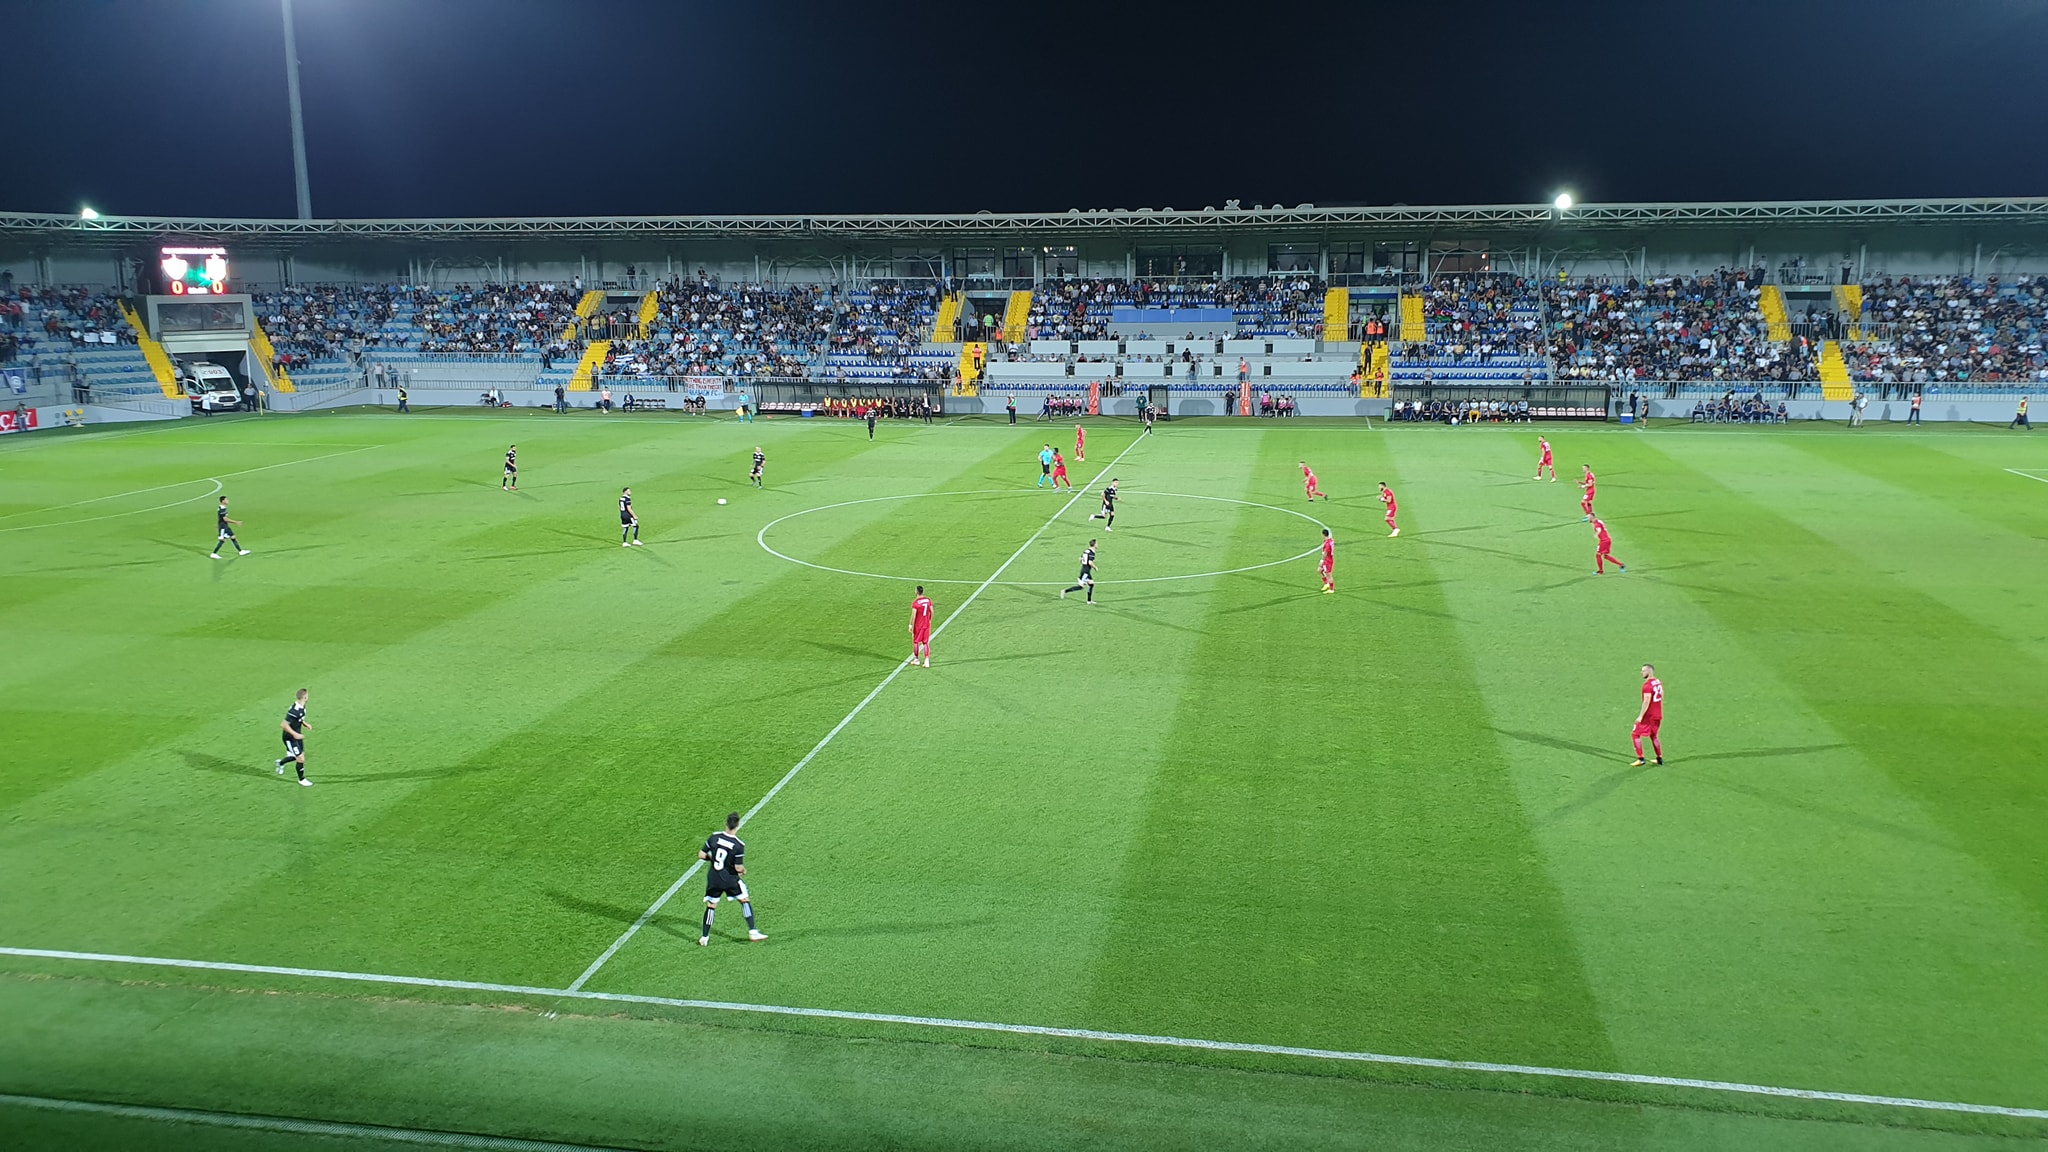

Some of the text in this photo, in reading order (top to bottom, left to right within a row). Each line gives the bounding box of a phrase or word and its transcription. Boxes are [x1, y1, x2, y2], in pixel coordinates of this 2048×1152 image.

[171, 280, 184, 294] 0
[212, 280, 224, 294] 0
[922, 603, 929, 616] 7
[713, 847, 728, 871] 9
